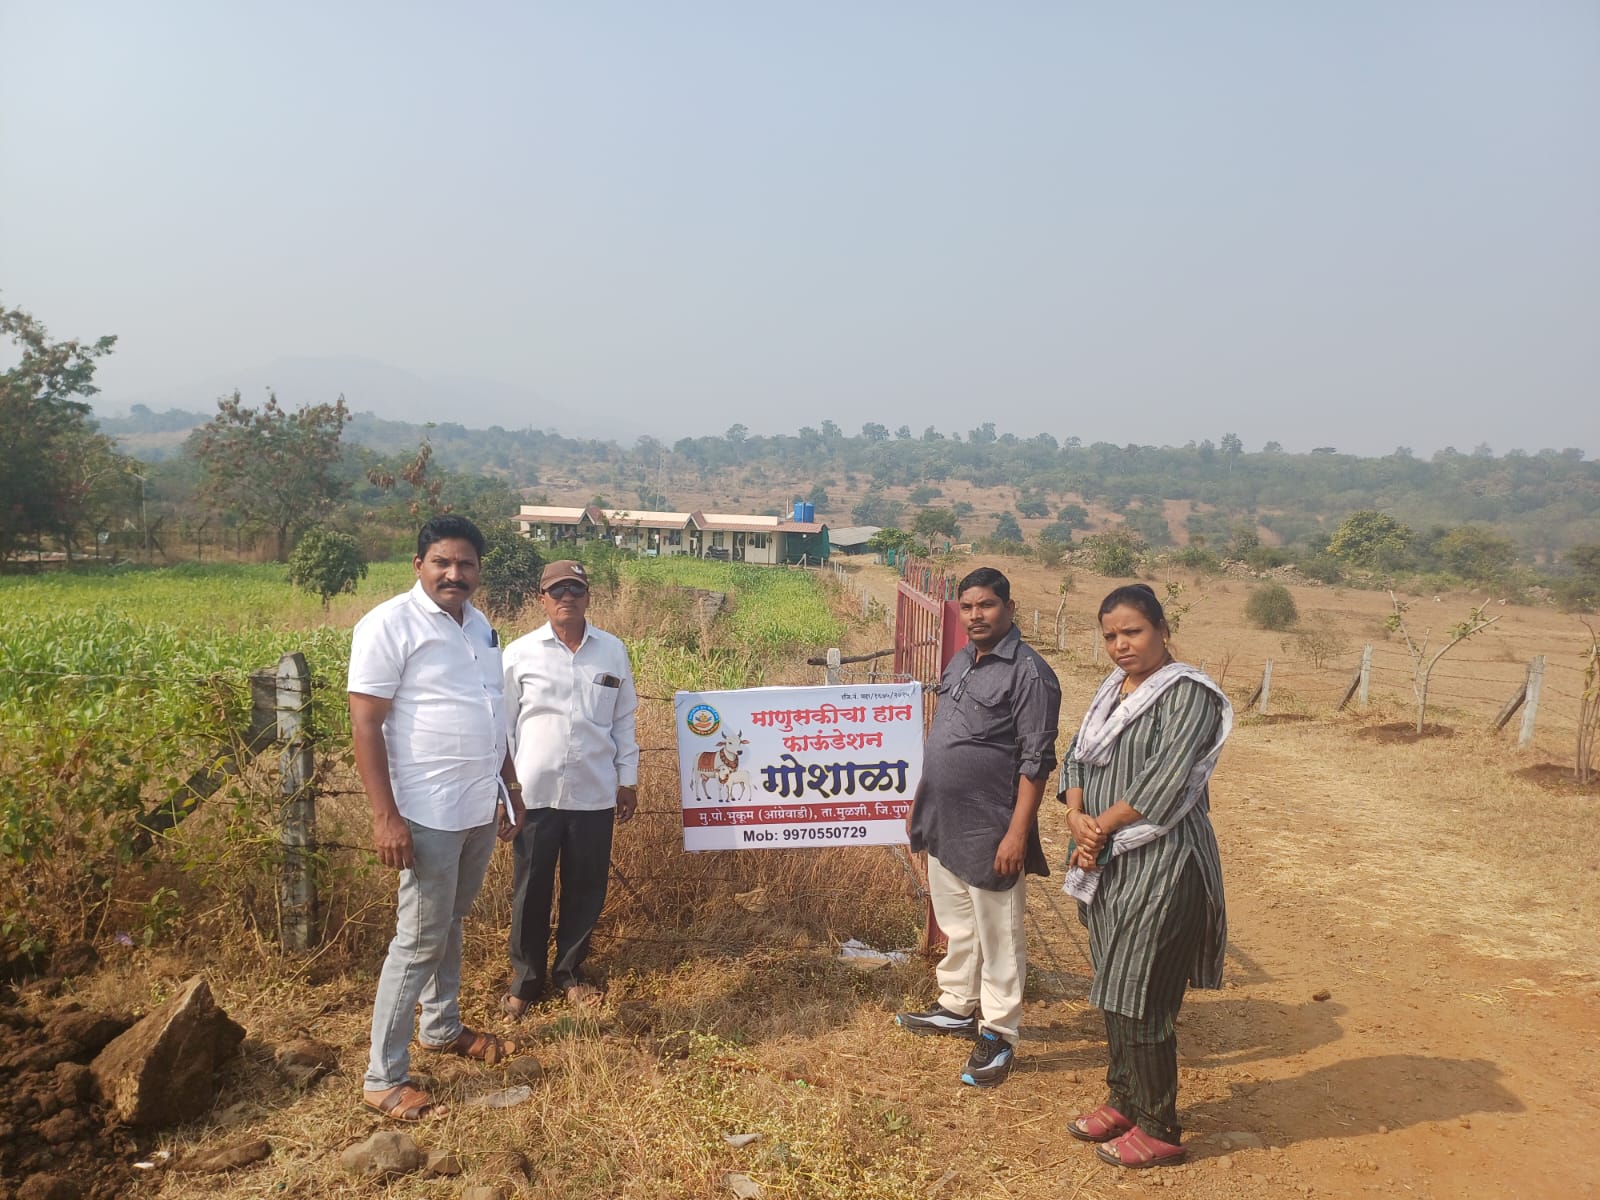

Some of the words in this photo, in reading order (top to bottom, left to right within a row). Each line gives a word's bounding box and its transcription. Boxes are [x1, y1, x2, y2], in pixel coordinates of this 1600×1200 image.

[751, 703, 866, 732] माणुसकीचा
[872, 704, 912, 723] हात
[783, 729, 883, 752] फाऊंडेशन
[760, 753, 909, 799] गोशाळा
[743, 830, 778, 842] Mob:
[783, 826, 867, 840] 9970550729
